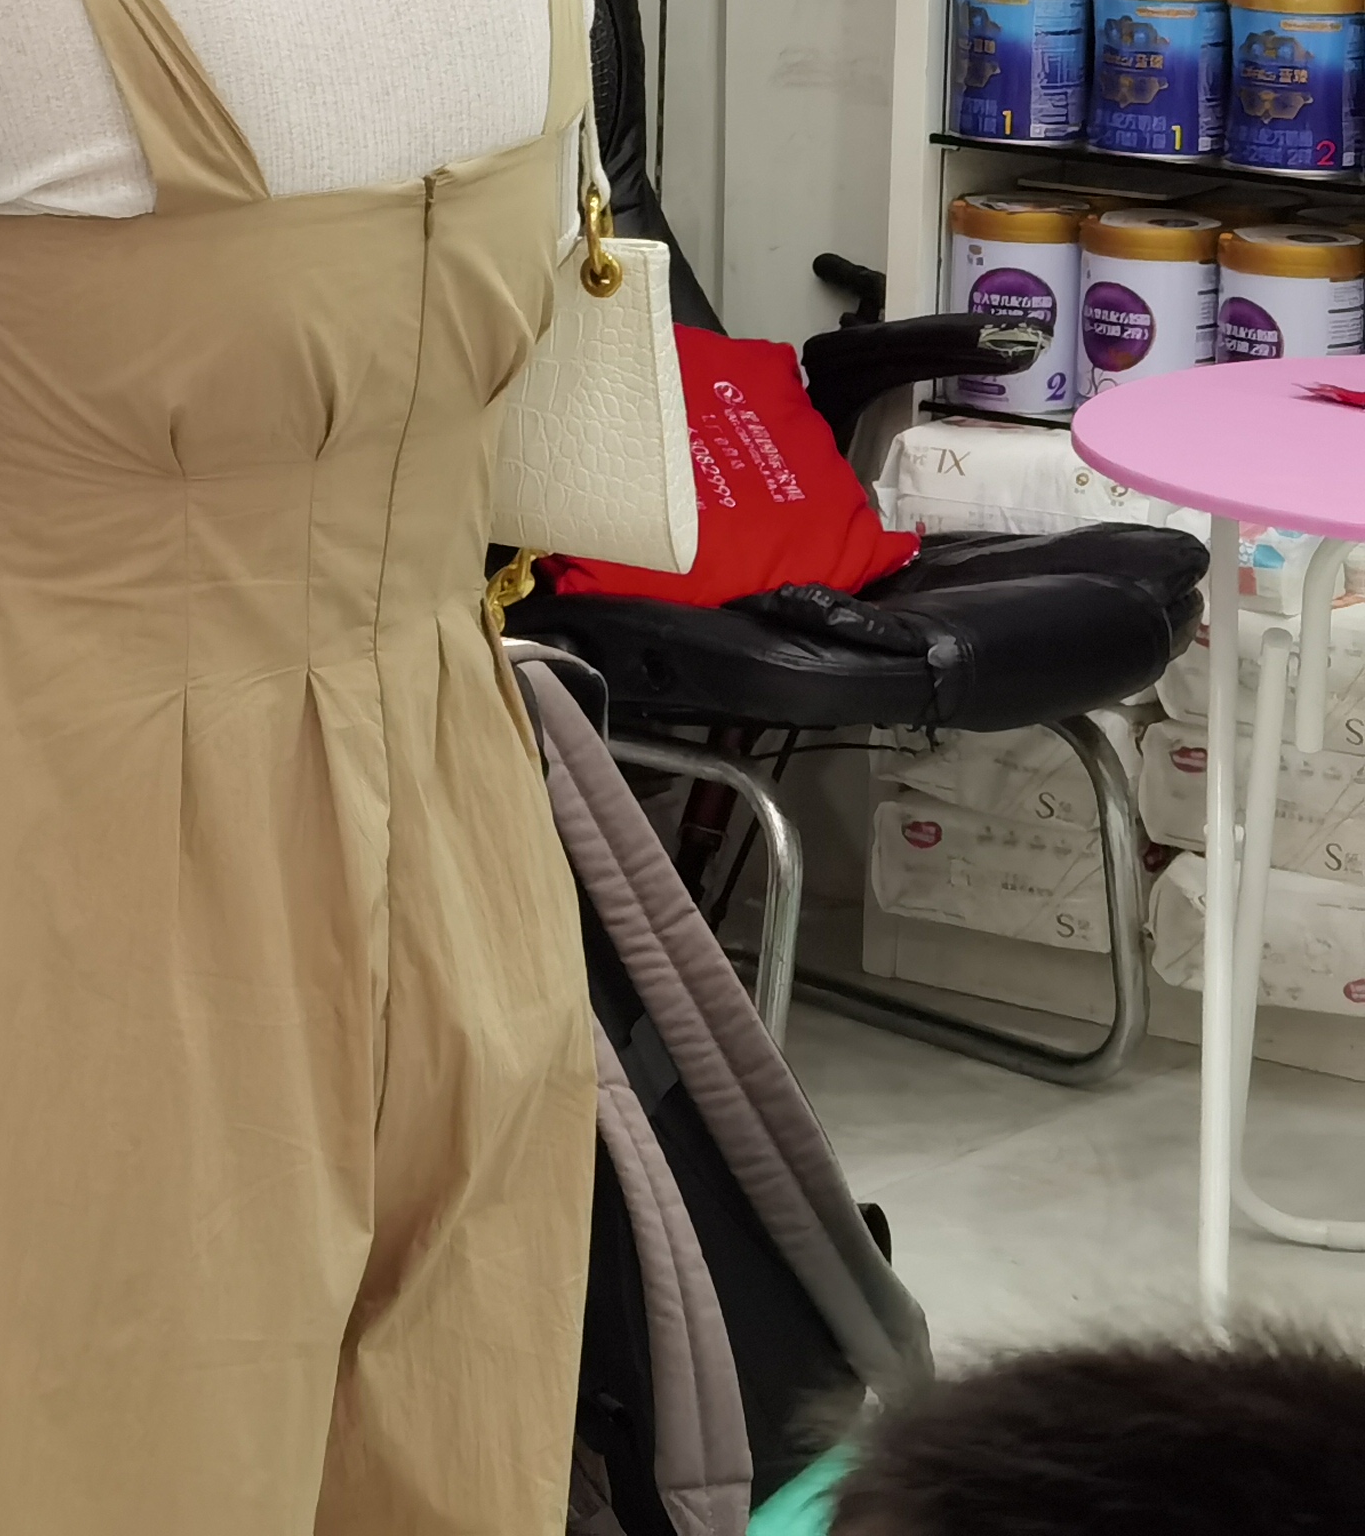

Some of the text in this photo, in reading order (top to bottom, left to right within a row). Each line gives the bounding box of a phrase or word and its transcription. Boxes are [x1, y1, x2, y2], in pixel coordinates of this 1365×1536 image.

[1003, 110, 1012, 135] 1
[1171, 125, 1181, 150] 1
[1315, 140, 1336, 166] 2
[1046, 371, 1068, 402] 2
